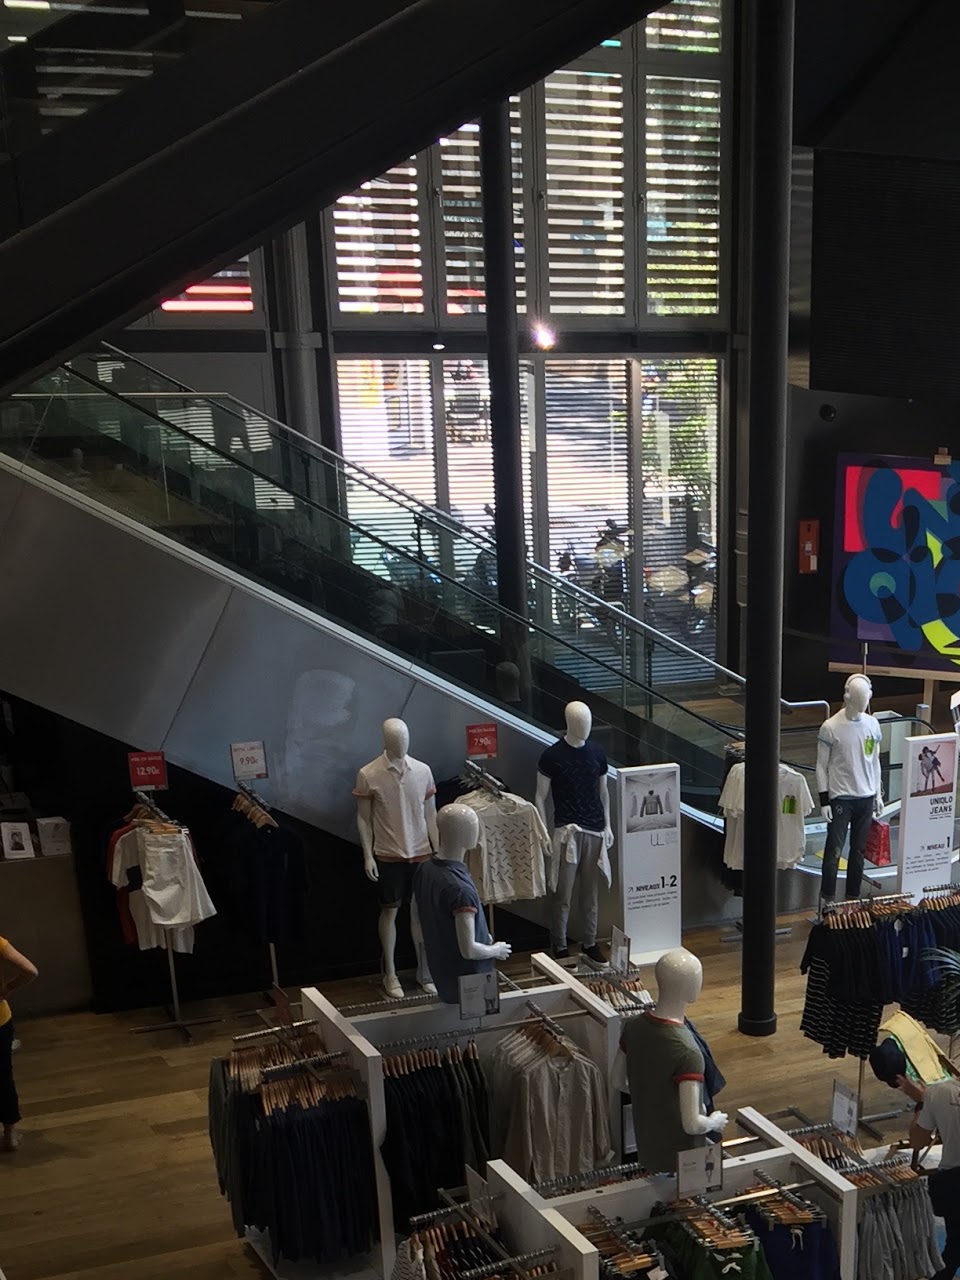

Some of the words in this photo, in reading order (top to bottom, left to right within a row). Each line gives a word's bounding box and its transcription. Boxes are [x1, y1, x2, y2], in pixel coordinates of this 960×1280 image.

[929, 796, 953, 806] UNIQLO
[929, 805, 953, 815] JEANS
[946, 836, 951, 848] 1
[635, 883, 660, 892] NIVEAUX
[660, 874, 678, 889] 1-2
